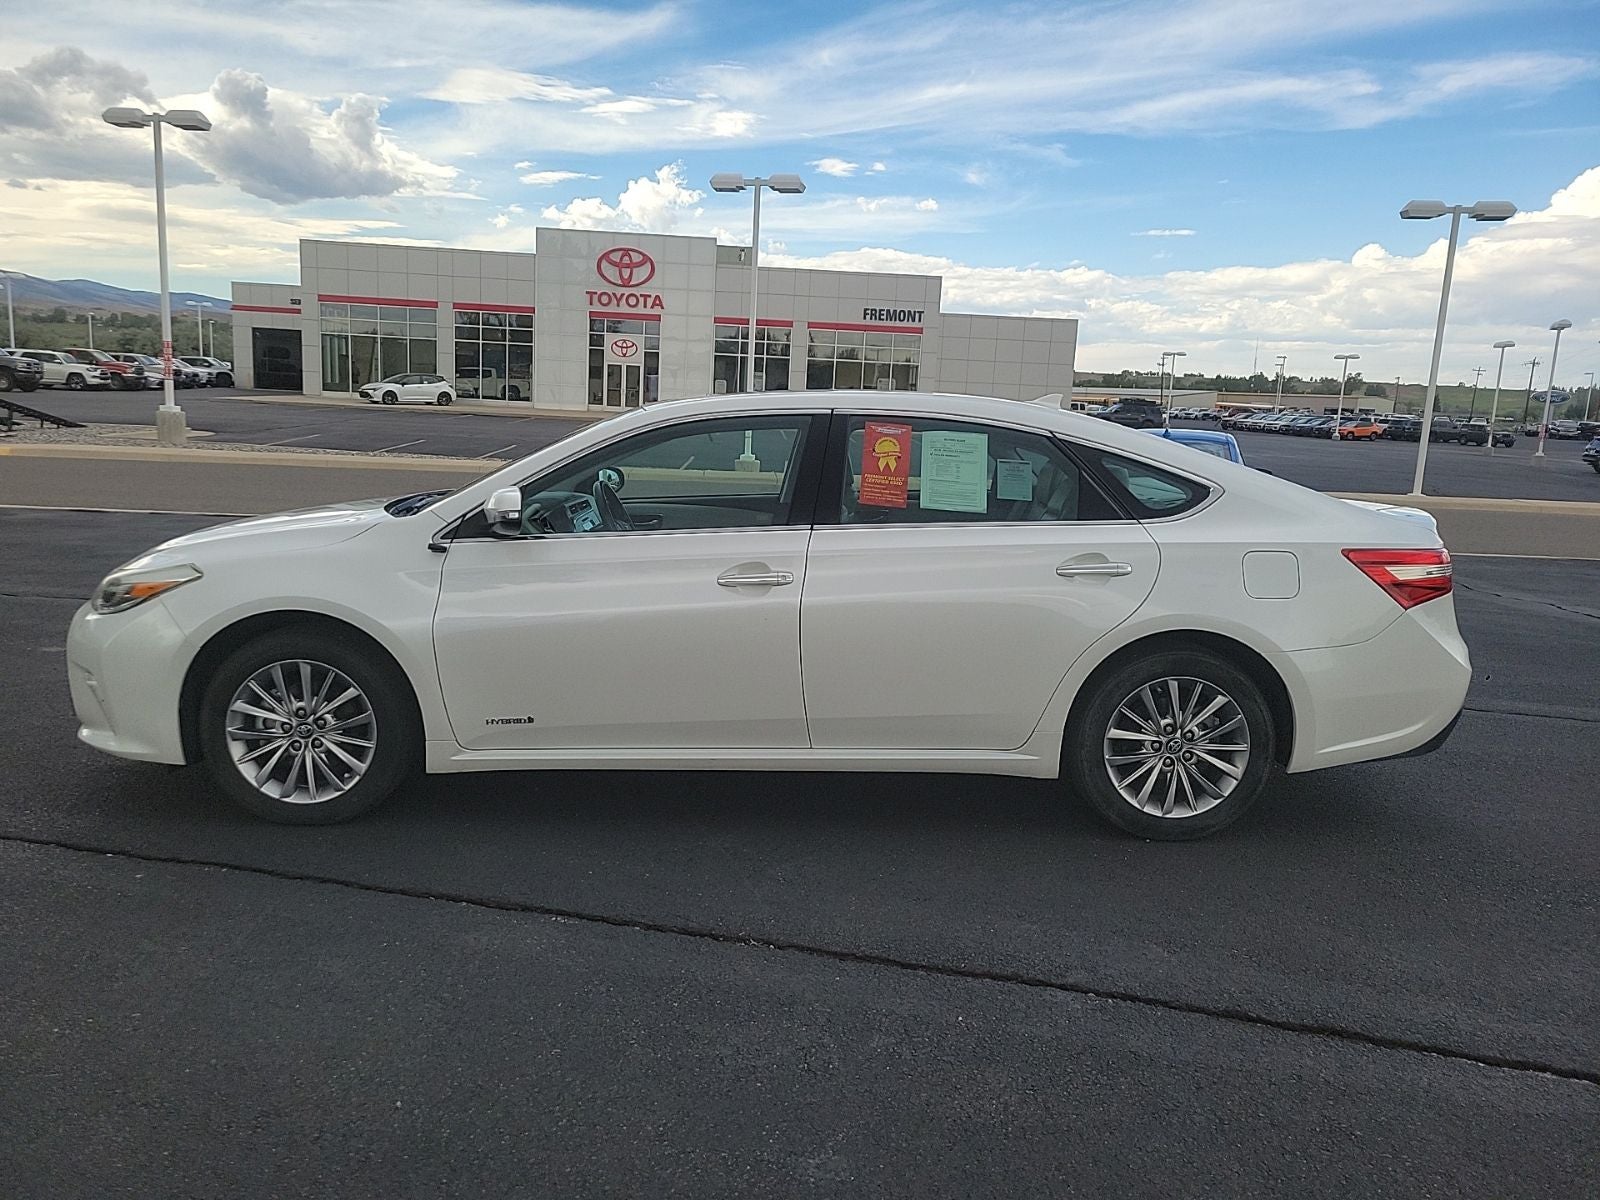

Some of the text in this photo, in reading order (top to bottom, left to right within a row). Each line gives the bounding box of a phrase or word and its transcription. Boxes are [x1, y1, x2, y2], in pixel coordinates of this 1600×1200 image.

[586, 290, 664, 309] TOYOTA
[863, 308, 924, 323] FREMONT
[485, 718, 527, 726] HYBRID
